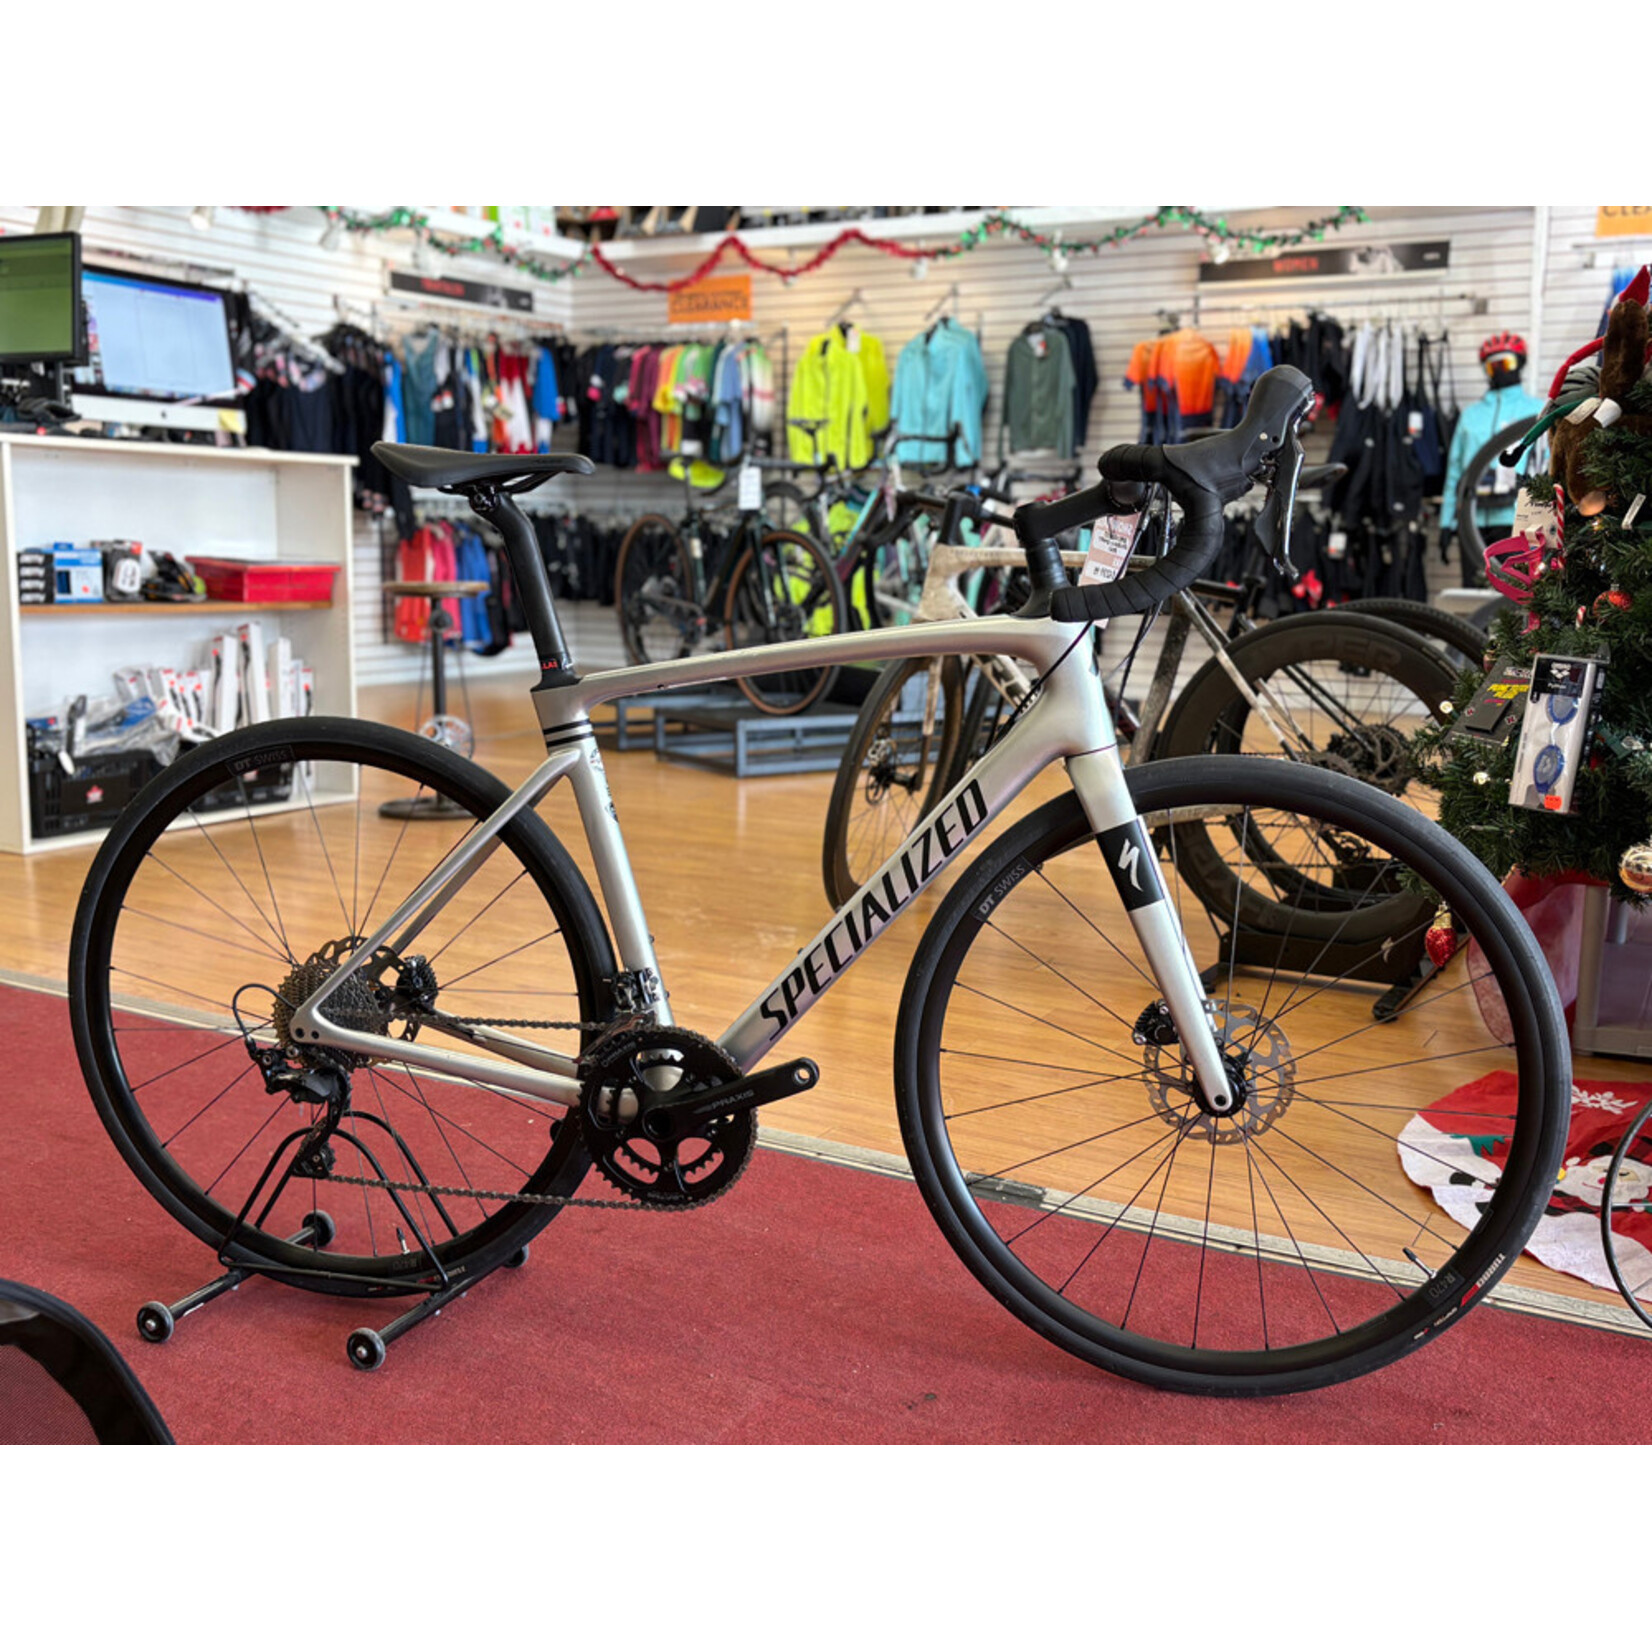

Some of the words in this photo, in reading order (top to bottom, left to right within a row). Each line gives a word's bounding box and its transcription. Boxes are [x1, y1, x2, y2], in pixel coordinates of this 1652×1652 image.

[759, 778, 989, 1042] SPECIALIZED
[978, 893, 996, 915] DT
[993, 863, 1026, 896] SWISS
[711, 1088, 755, 1110] PRAXIS
